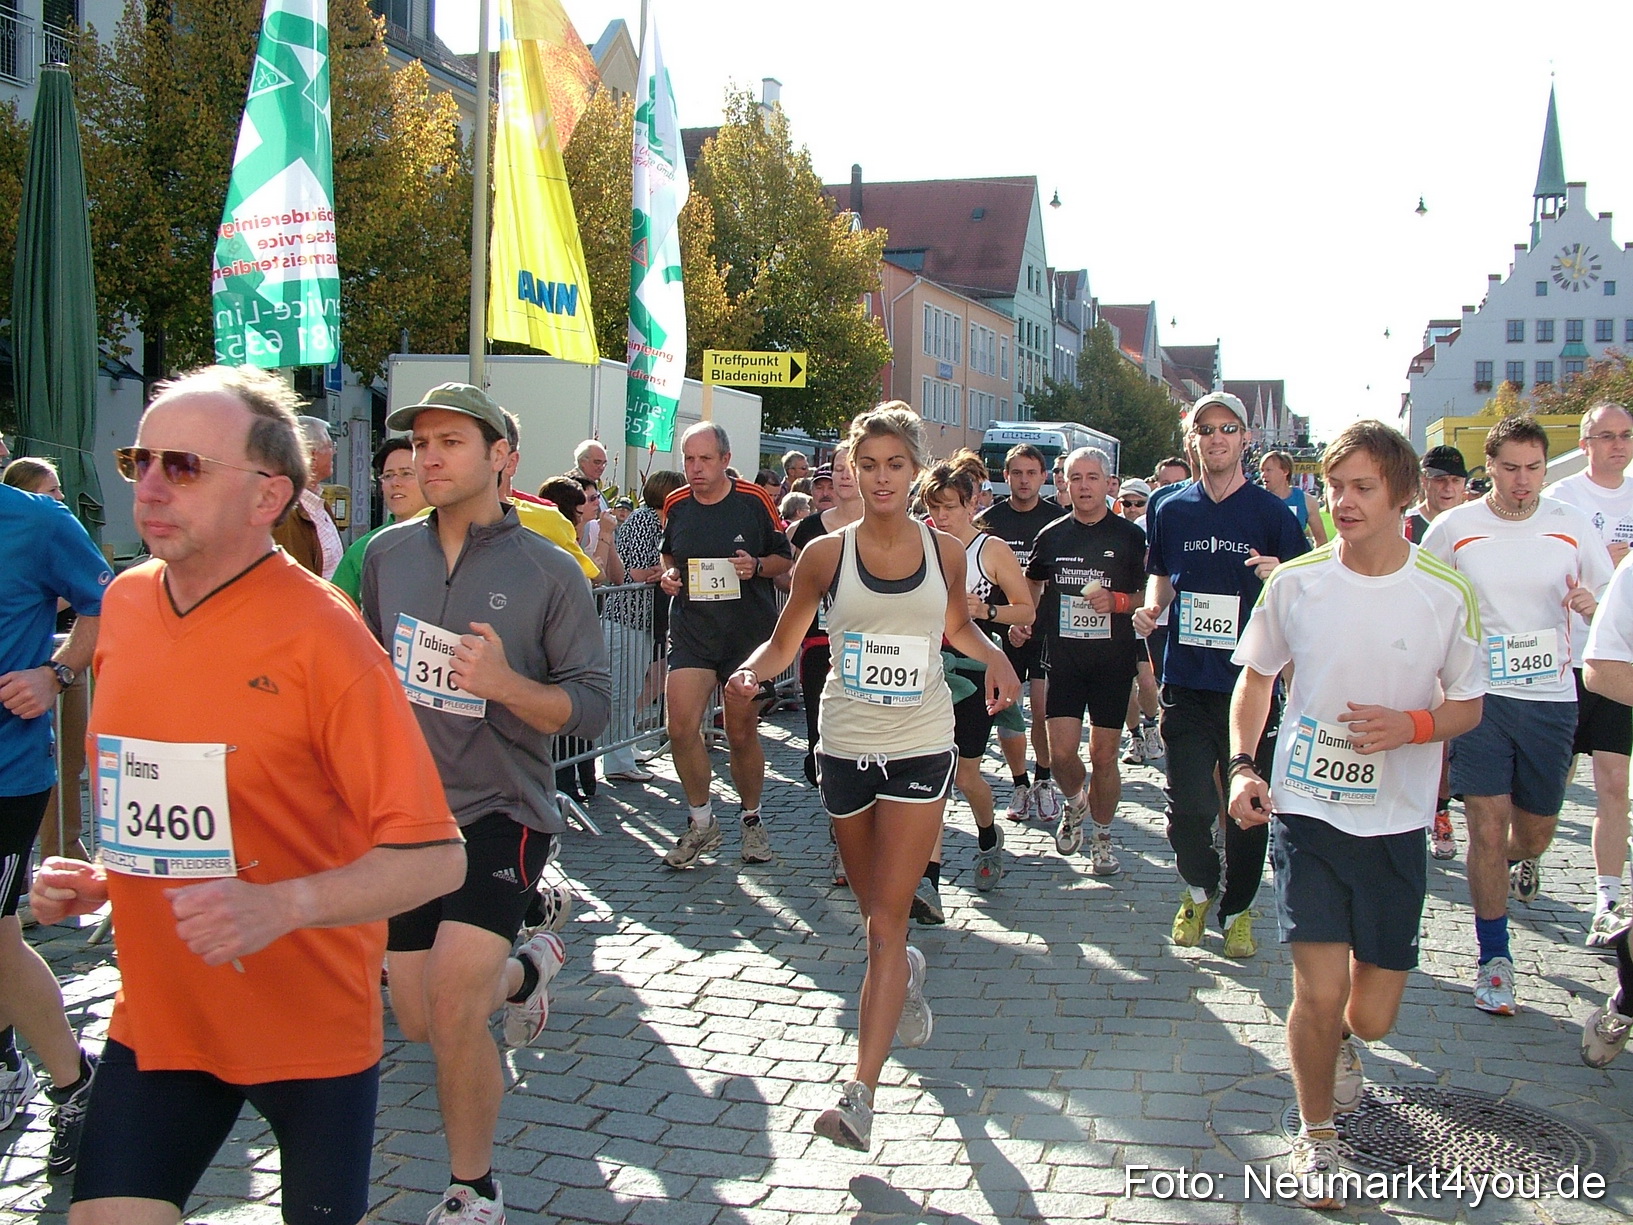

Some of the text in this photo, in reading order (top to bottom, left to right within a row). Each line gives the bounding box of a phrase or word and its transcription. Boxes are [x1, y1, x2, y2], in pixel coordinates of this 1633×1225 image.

[518, 270, 578, 317] ANN
[712, 353, 779, 368] Treffpunkt
[711, 369, 783, 384] Bladenight
[1001, 431, 1041, 440] BOCK
[1183, 540, 1250, 554] EURO POLES
[701, 562, 715, 571] Rudi
[1061, 567, 1105, 576] Neumarkter
[710, 577, 726, 589] 31
[1193, 598, 1210, 609] Dani
[1073, 615, 1106, 627] 2997
[1194, 617, 1232, 634] 2462
[419, 629, 456, 656] Tobias
[865, 640, 900, 656] Hanna
[1507, 636, 1538, 650] Manuel
[844, 658, 851, 669] C
[1510, 653, 1553, 672] 3480
[865, 665, 919, 687] 2091
[444, 700, 484, 713] PFLEIDERER
[1294, 744, 1302, 756] C
[125, 751, 159, 780] Hans
[1313, 757, 1375, 784] 2088
[102, 787, 109, 806] C
[126, 801, 216, 841] 3460
[170, 858, 232, 870] PFLEIDERER
